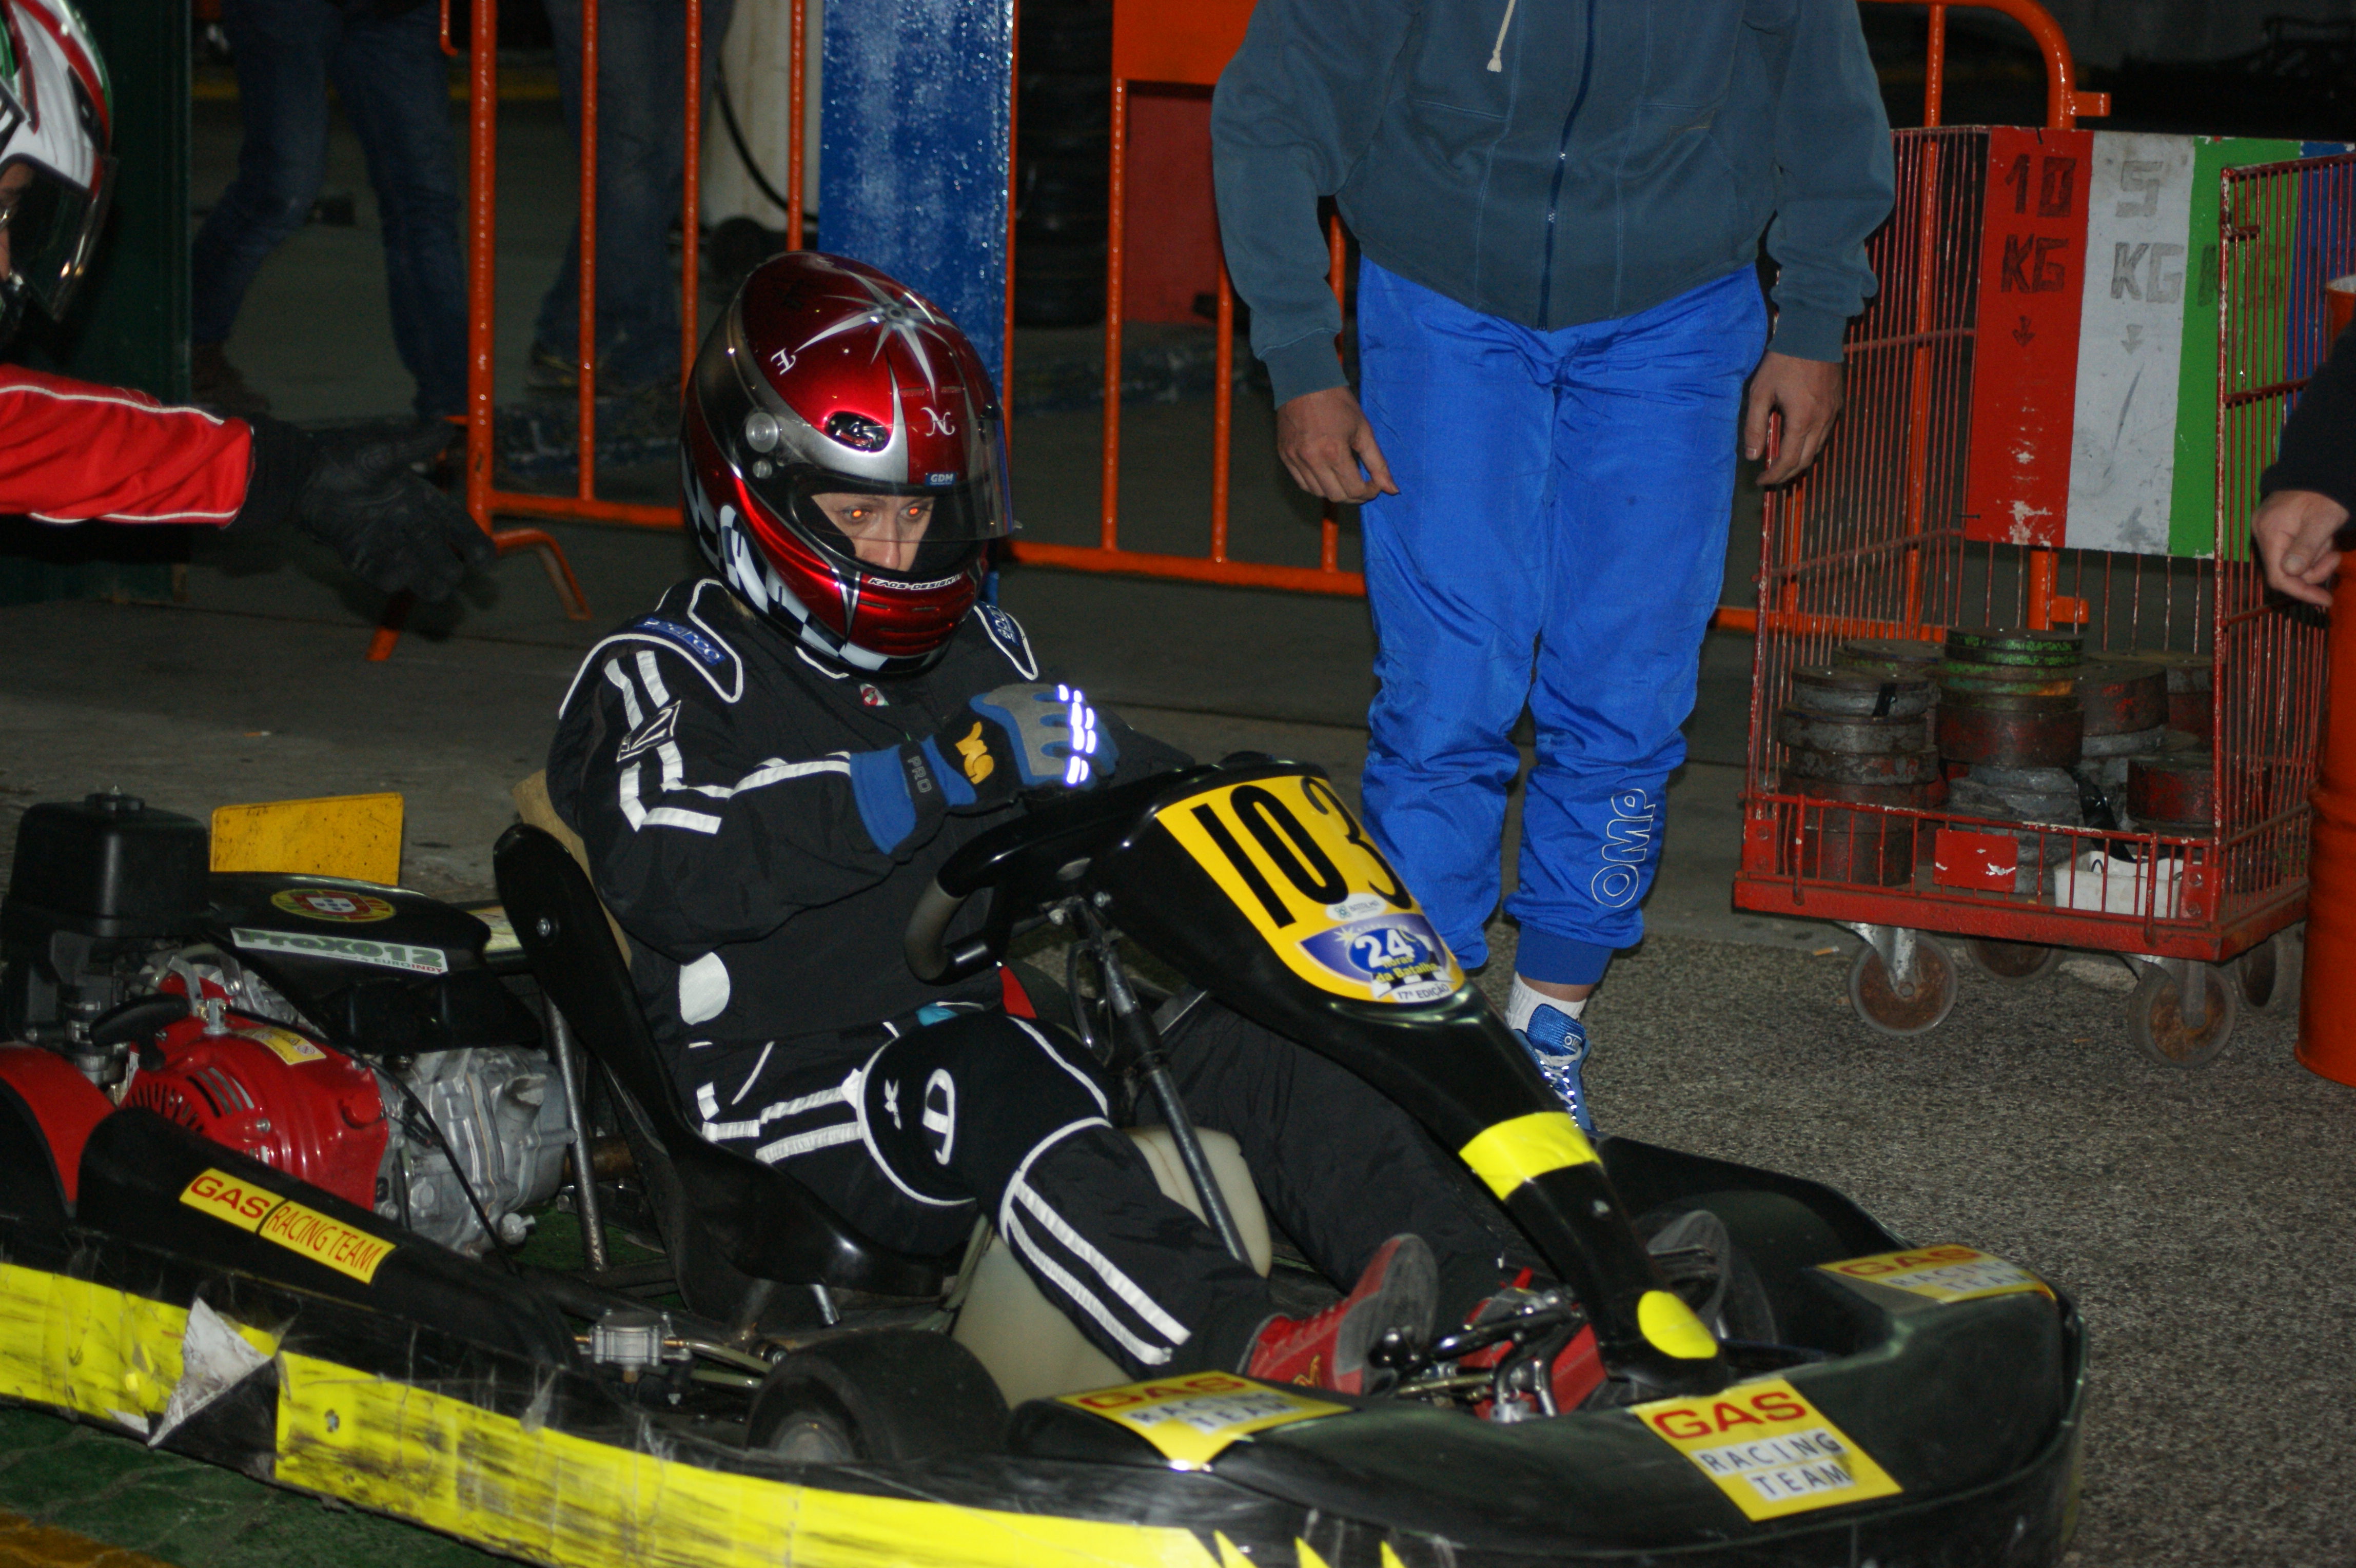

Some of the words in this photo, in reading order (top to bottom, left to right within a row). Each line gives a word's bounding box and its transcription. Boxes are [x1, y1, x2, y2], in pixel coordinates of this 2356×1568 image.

[2005, 154, 2077, 218] 10
[2000, 233, 2069, 295] KG
[2110, 242, 2185, 304] KG
[920, 406, 956, 437] N
[930, 473, 954, 483] GDM
[907, 756, 933, 793] PRO
[1190, 776, 1412, 929] 103
[1591, 788, 1656, 908] OMP
[1354, 929, 1415, 969] 24
[1382, 955, 1415, 969] horas
[1376, 970, 1395, 984] da
[1392, 962, 1440, 978] Batalha
[1417, 982, 1450, 999] EDIÇÃO
[190, 1175, 271, 1219] GAS
[266, 1206, 337, 1252] RACING
[327, 1230, 383, 1273] TEAM
[1839, 1248, 1982, 1276] GAS
[1078, 1376, 1246, 1409] GAS
[1652, 1391, 1807, 1440] GAS
[1699, 1432, 1844, 1473] RACING
[1751, 1464, 1851, 1497] TEAM
